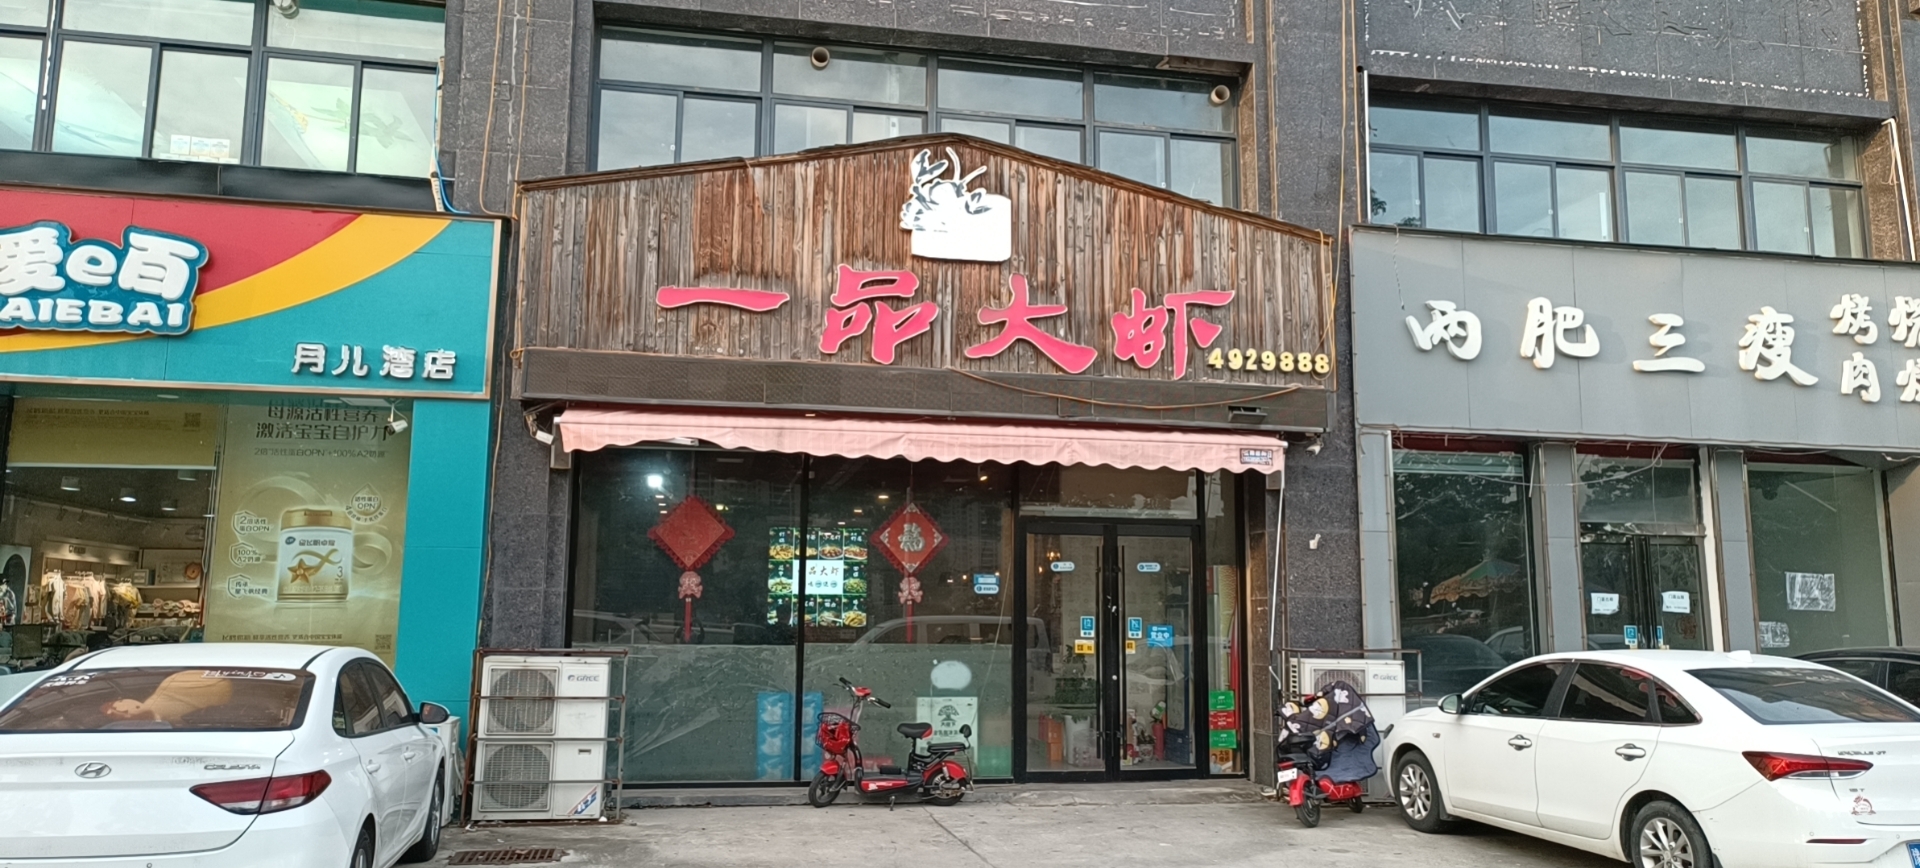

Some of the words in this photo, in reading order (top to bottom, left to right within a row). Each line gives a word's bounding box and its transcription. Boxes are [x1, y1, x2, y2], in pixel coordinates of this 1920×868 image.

[0, 297, 185, 327] AIEBAI
[656, 263, 1235, 380] 一品大虾
[1405, 297, 1819, 386] 两肥三瘦
[291, 342, 457, 380] 月儿湾店
[1207, 347, 1330, 374] 4929888
[255, 421, 387, 441] 激活宝宝自护力
[357, 502, 377, 510] OPN
